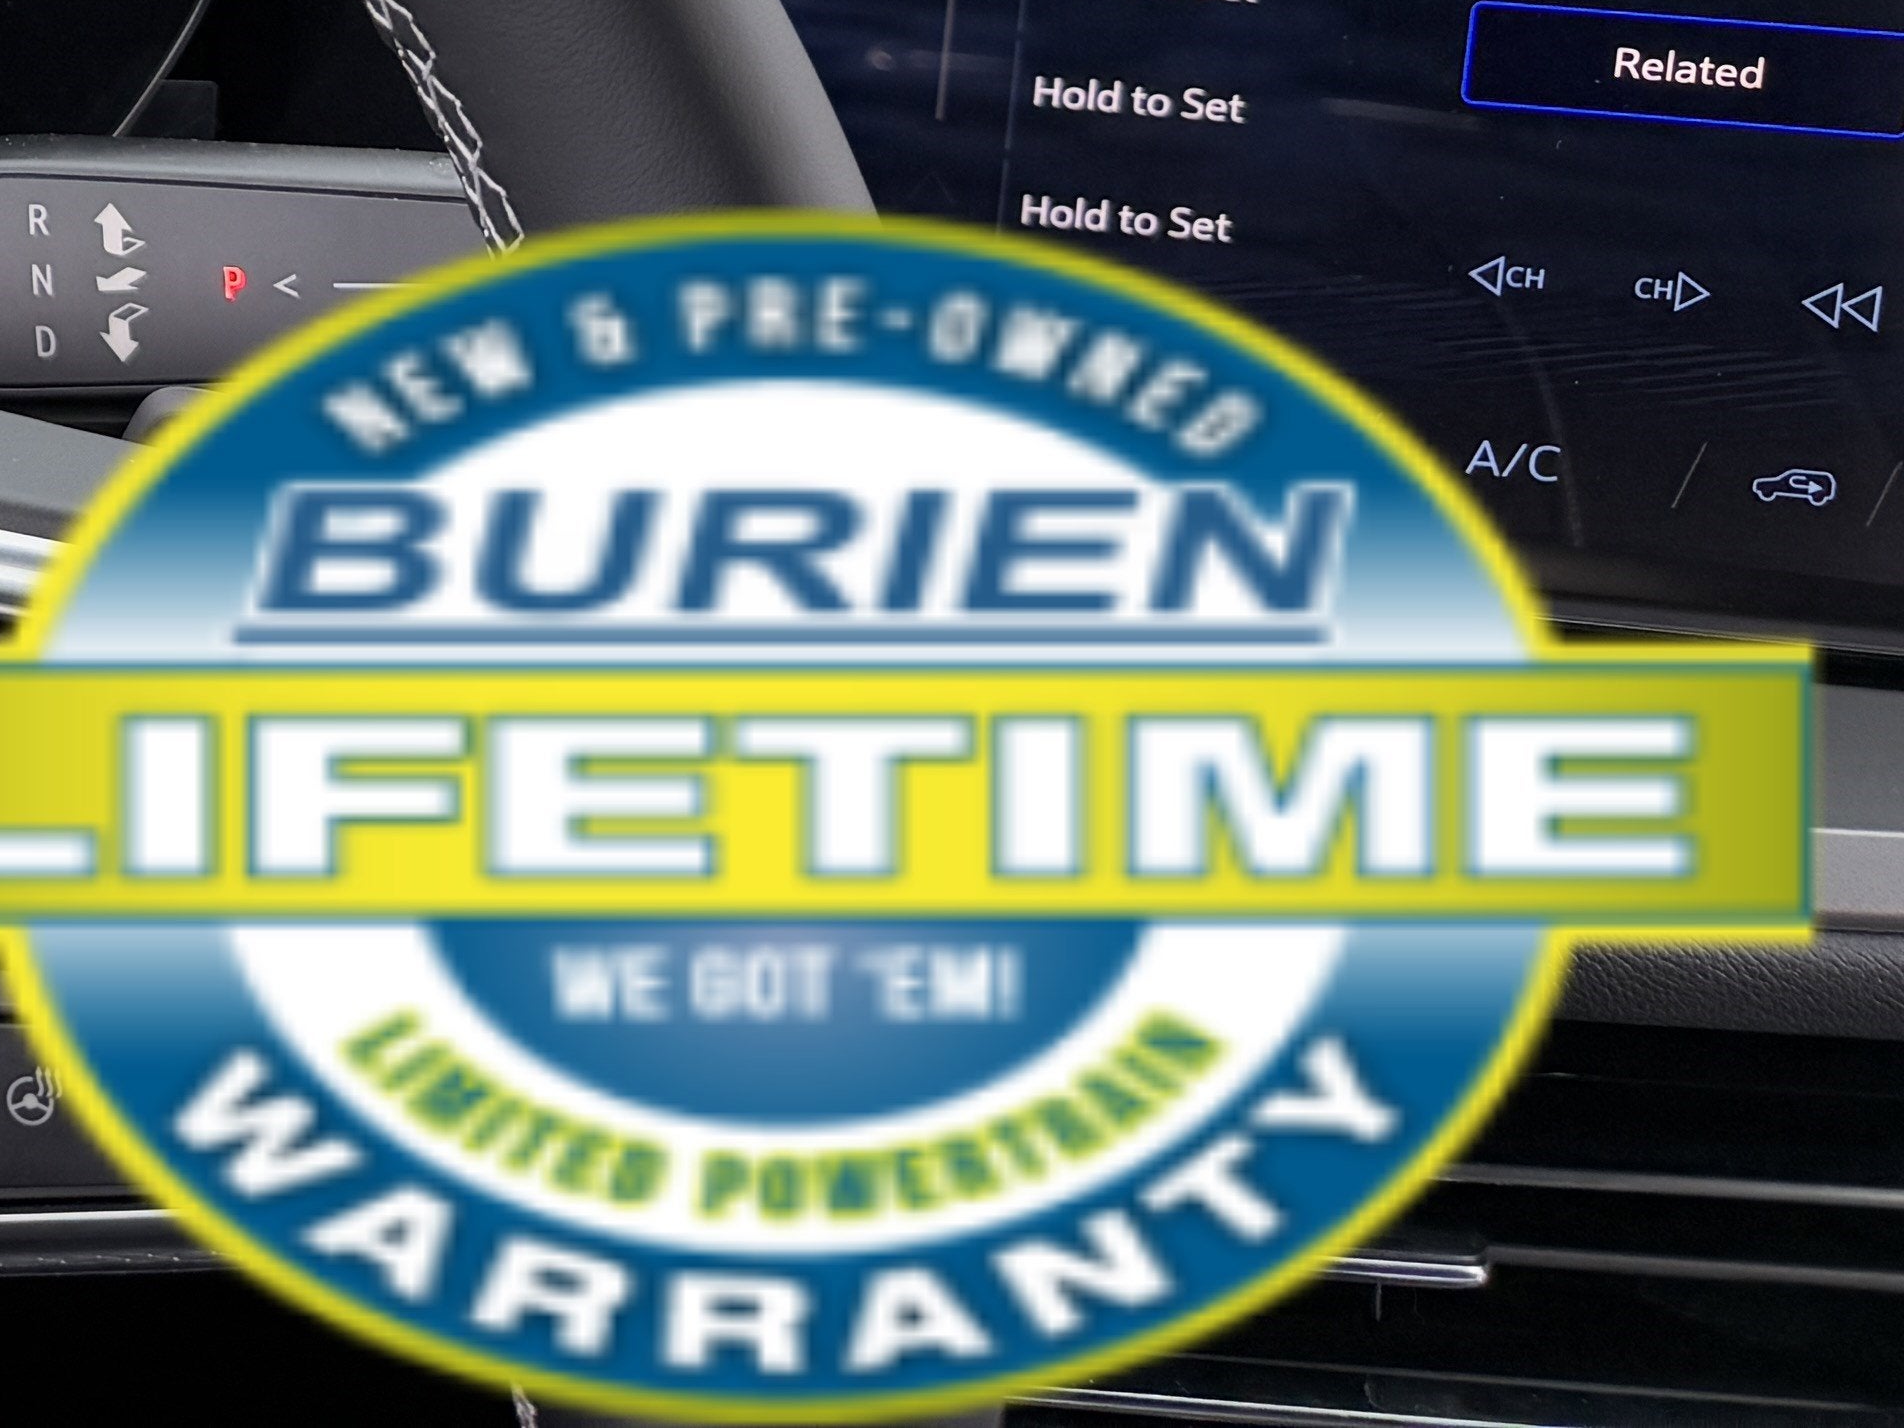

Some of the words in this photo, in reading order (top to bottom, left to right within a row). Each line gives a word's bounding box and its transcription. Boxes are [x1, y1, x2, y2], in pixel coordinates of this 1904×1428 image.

[1613, 46, 1766, 89] Related
[1032, 75, 1123, 113] Hold
[1130, 86, 1172, 117] to
[1180, 87, 1245, 124] Set
[28, 203, 50, 238] R
[1020, 194, 1110, 232] Hold
[1118, 205, 1159, 236] to
[1167, 206, 1232, 243] Set
[32, 264, 54, 297] N
[222, 266, 245, 300] P
[1506, 264, 1546, 290] CH
[1634, 276, 1674, 300] CH
[36, 325, 56, 358] D
[1465, 440, 1561, 482] A/C
